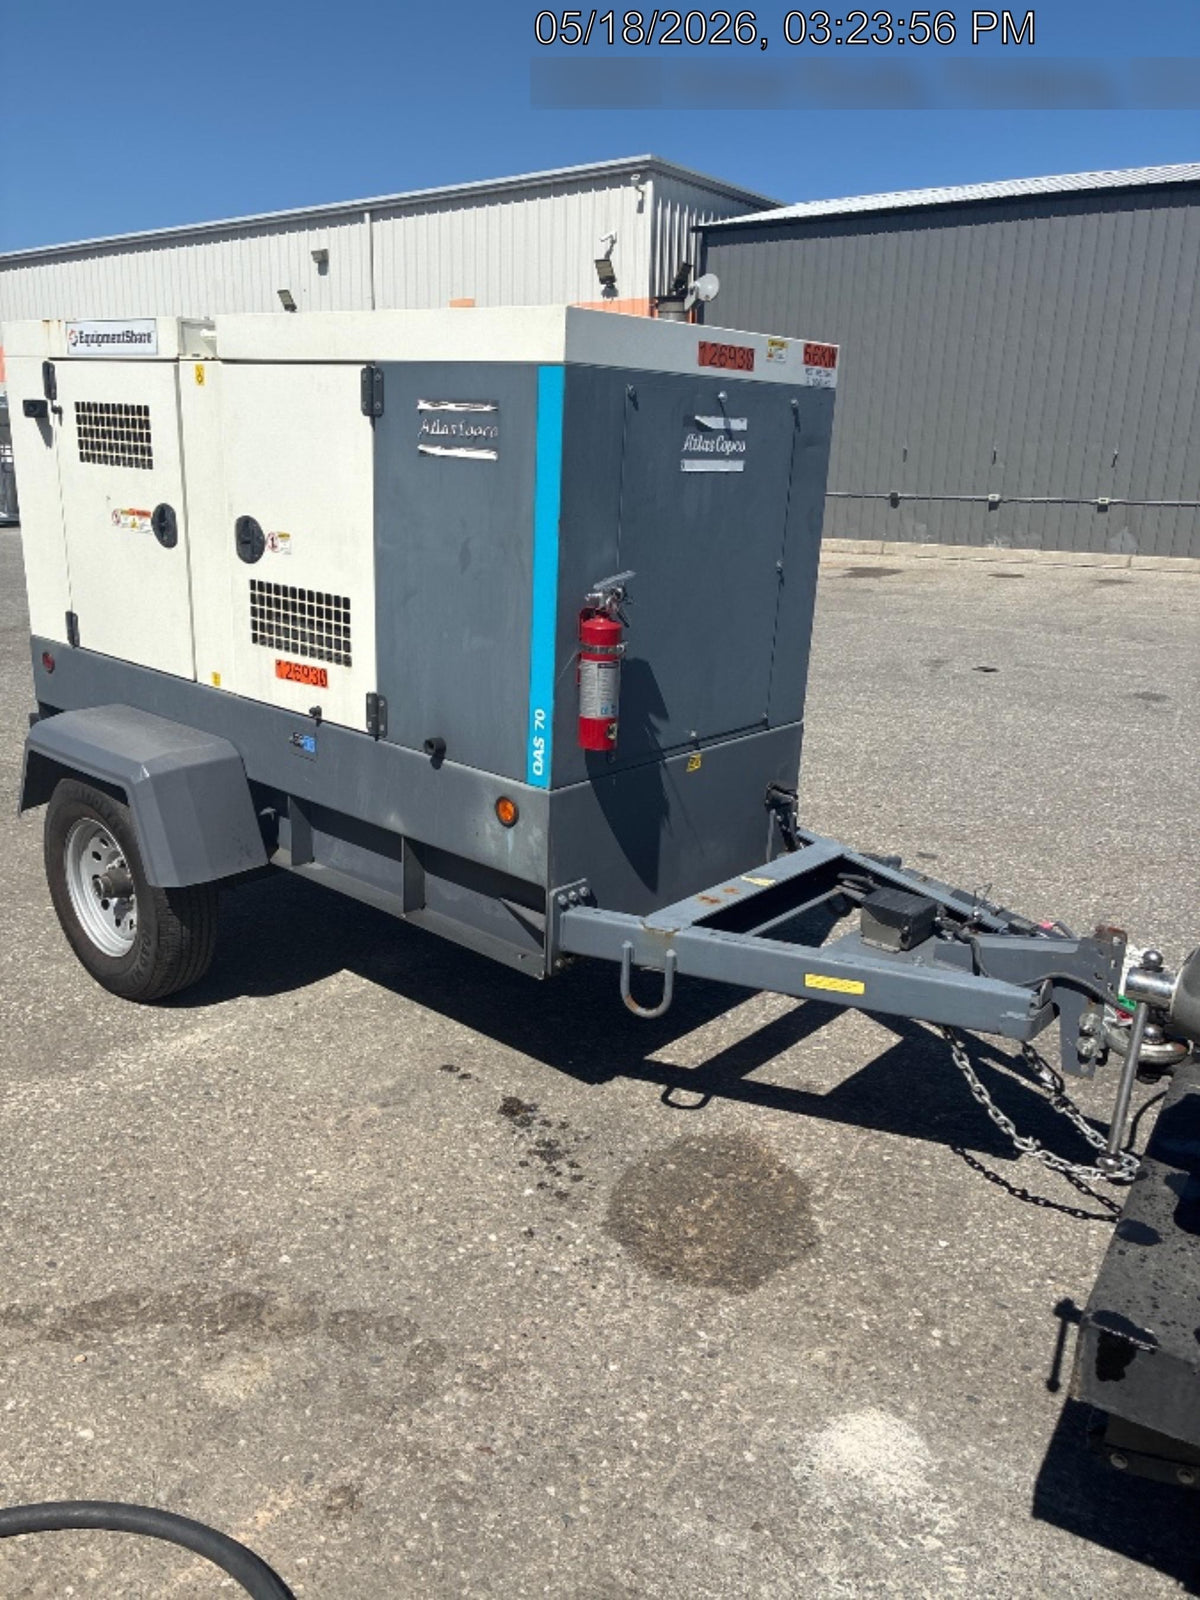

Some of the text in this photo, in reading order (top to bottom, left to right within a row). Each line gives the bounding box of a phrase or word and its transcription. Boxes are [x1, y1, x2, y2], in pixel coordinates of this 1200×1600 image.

[79, 329, 152, 347] EquipmentShare
[699, 341, 754, 371] 126930
[681, 433, 746, 455] Atlas Copco
[534, 708, 546, 731] 70
